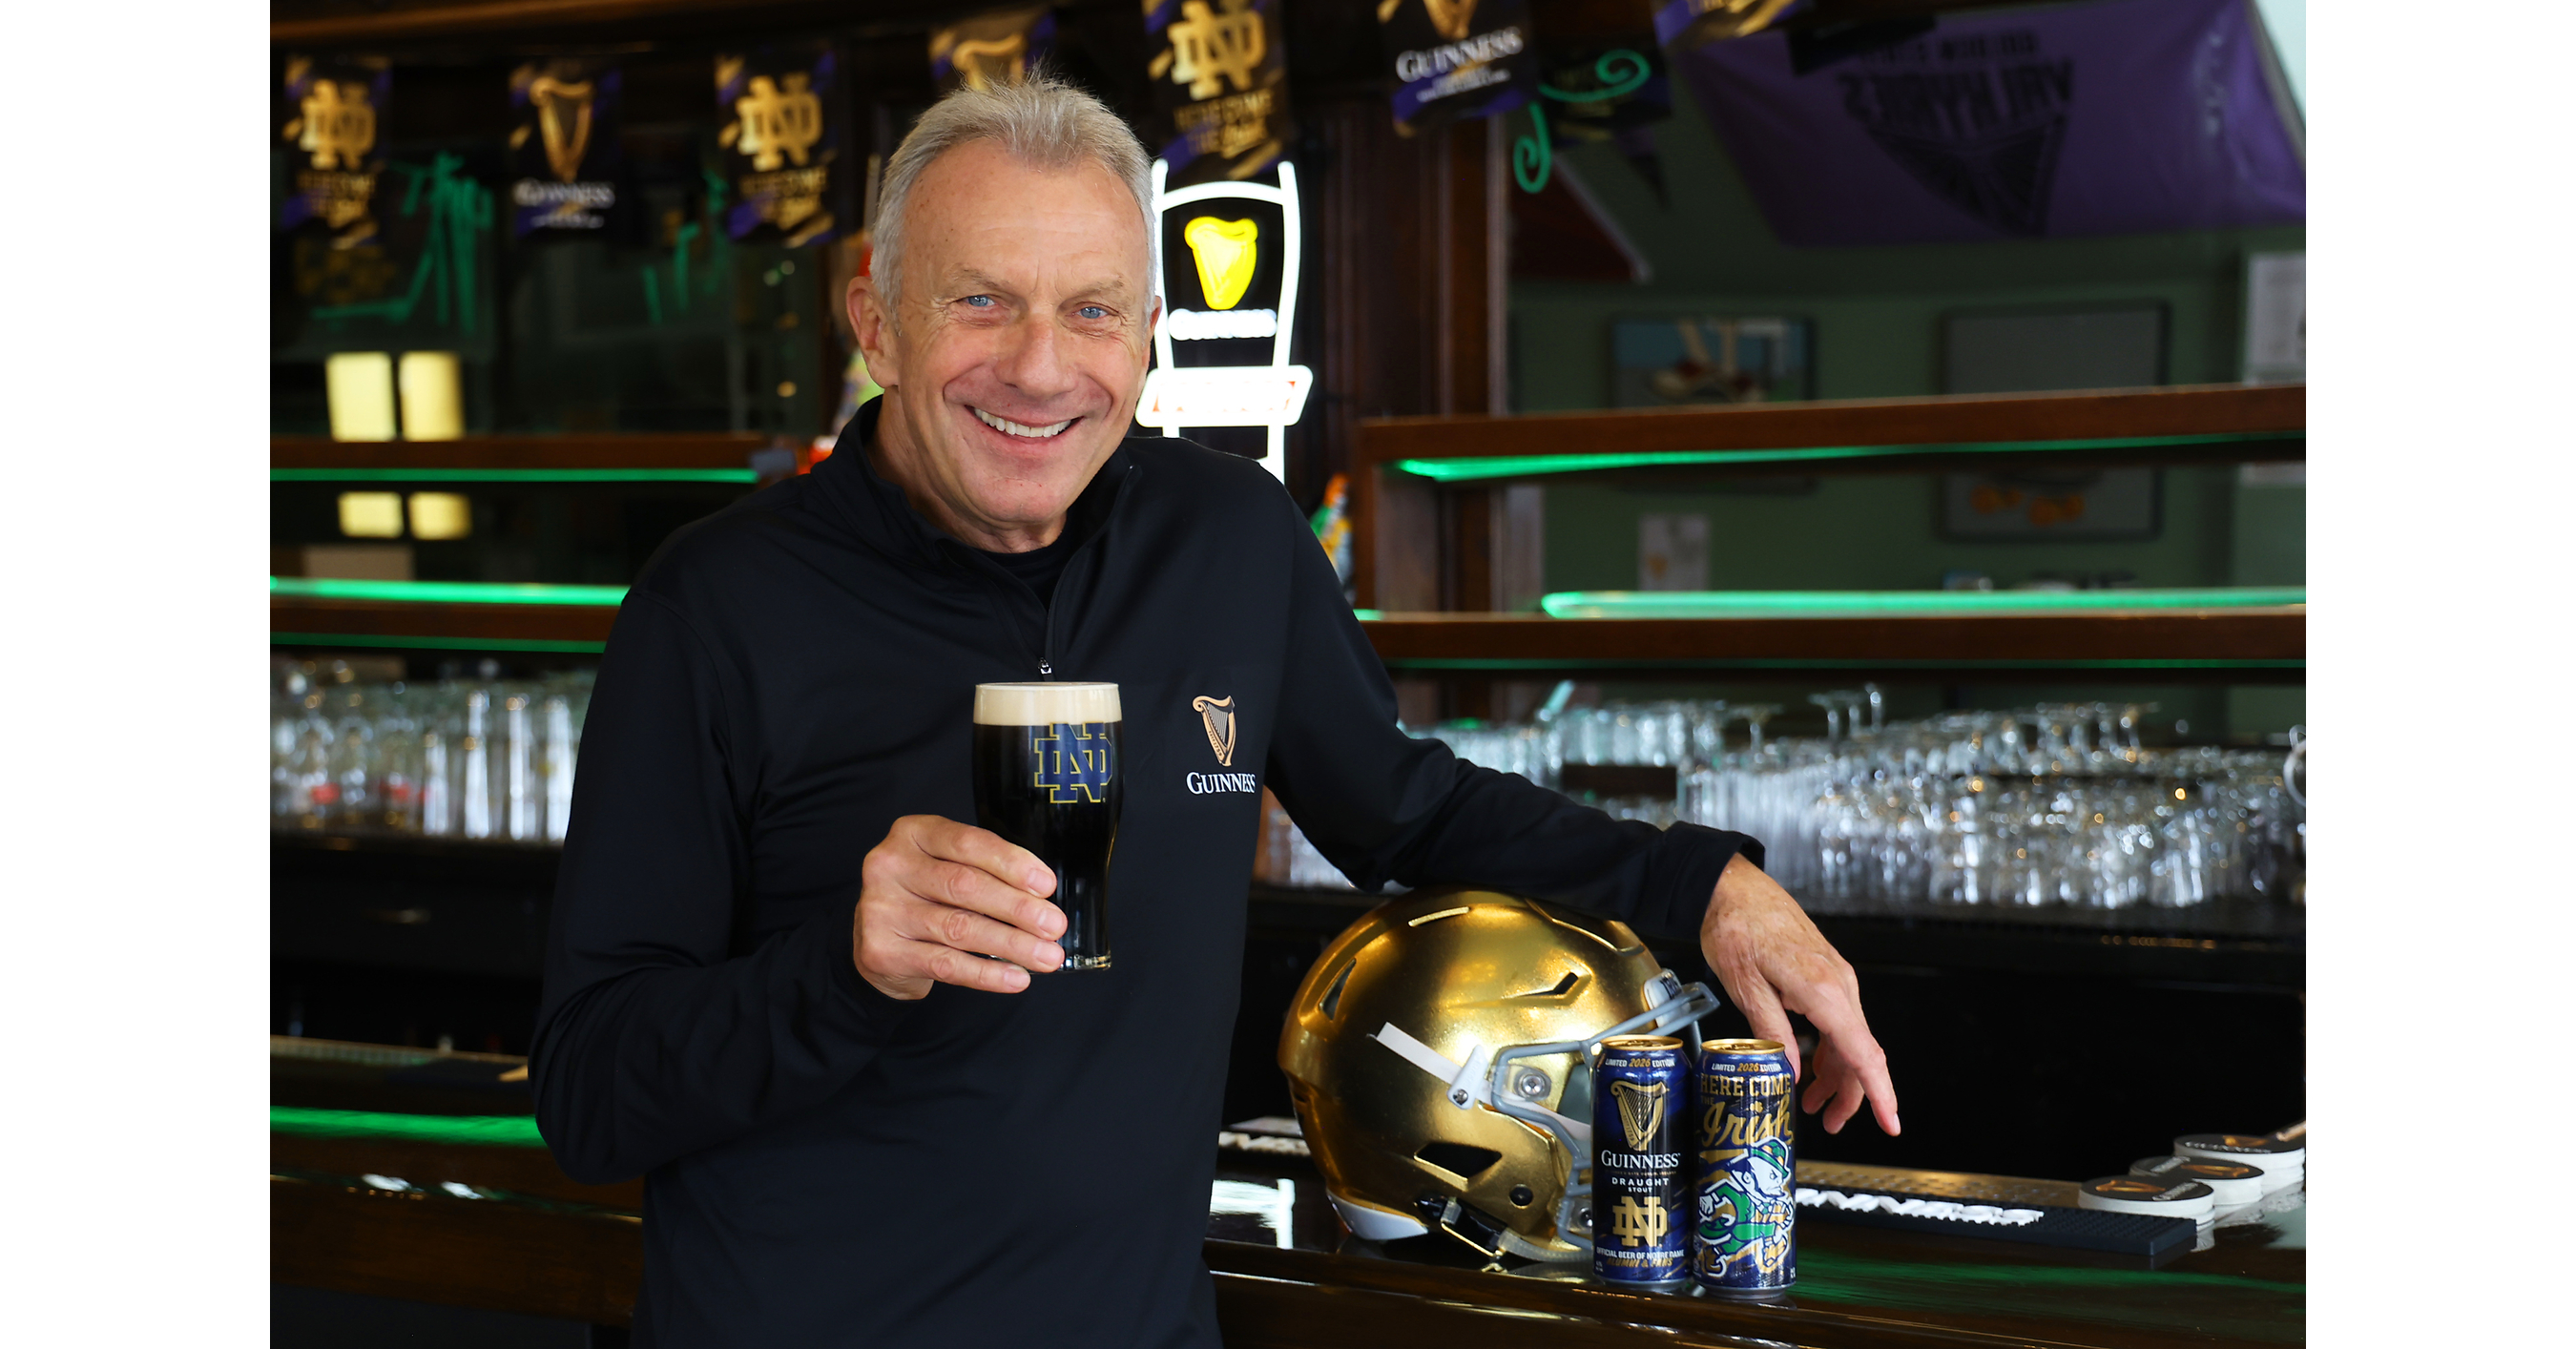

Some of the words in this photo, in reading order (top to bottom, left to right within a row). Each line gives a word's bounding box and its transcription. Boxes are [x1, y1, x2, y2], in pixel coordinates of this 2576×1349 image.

[1396, 26, 1524, 82] GUINNESS
[1186, 771, 1256, 795] GUINNESS
[1605, 1058, 1628, 1068] LIMITED
[1629, 1058, 1651, 1068] 2026
[1652, 1057, 1675, 1068] EDITION
[1711, 1063, 1735, 1071] LIMITED
[1737, 1063, 1760, 1072] 2026
[1759, 1063, 1782, 1072] EDITION
[1700, 1072, 1745, 1097] HERE
[1749, 1072, 1792, 1097] COME
[1701, 1093, 1794, 1148] Irish
[1601, 1150, 1679, 1170] GUINNESS
[1611, 1176, 1670, 1187] DRAUGHT
[1618, 1251, 1635, 1259] BEER
[1647, 1251, 1669, 1259] NOTRE
[1669, 1249, 1685, 1257] DAME
[1607, 1258, 1640, 1268] ALUMNI
[1641, 1259, 1649, 1268] &
[1651, 1258, 1673, 1268] FANS
